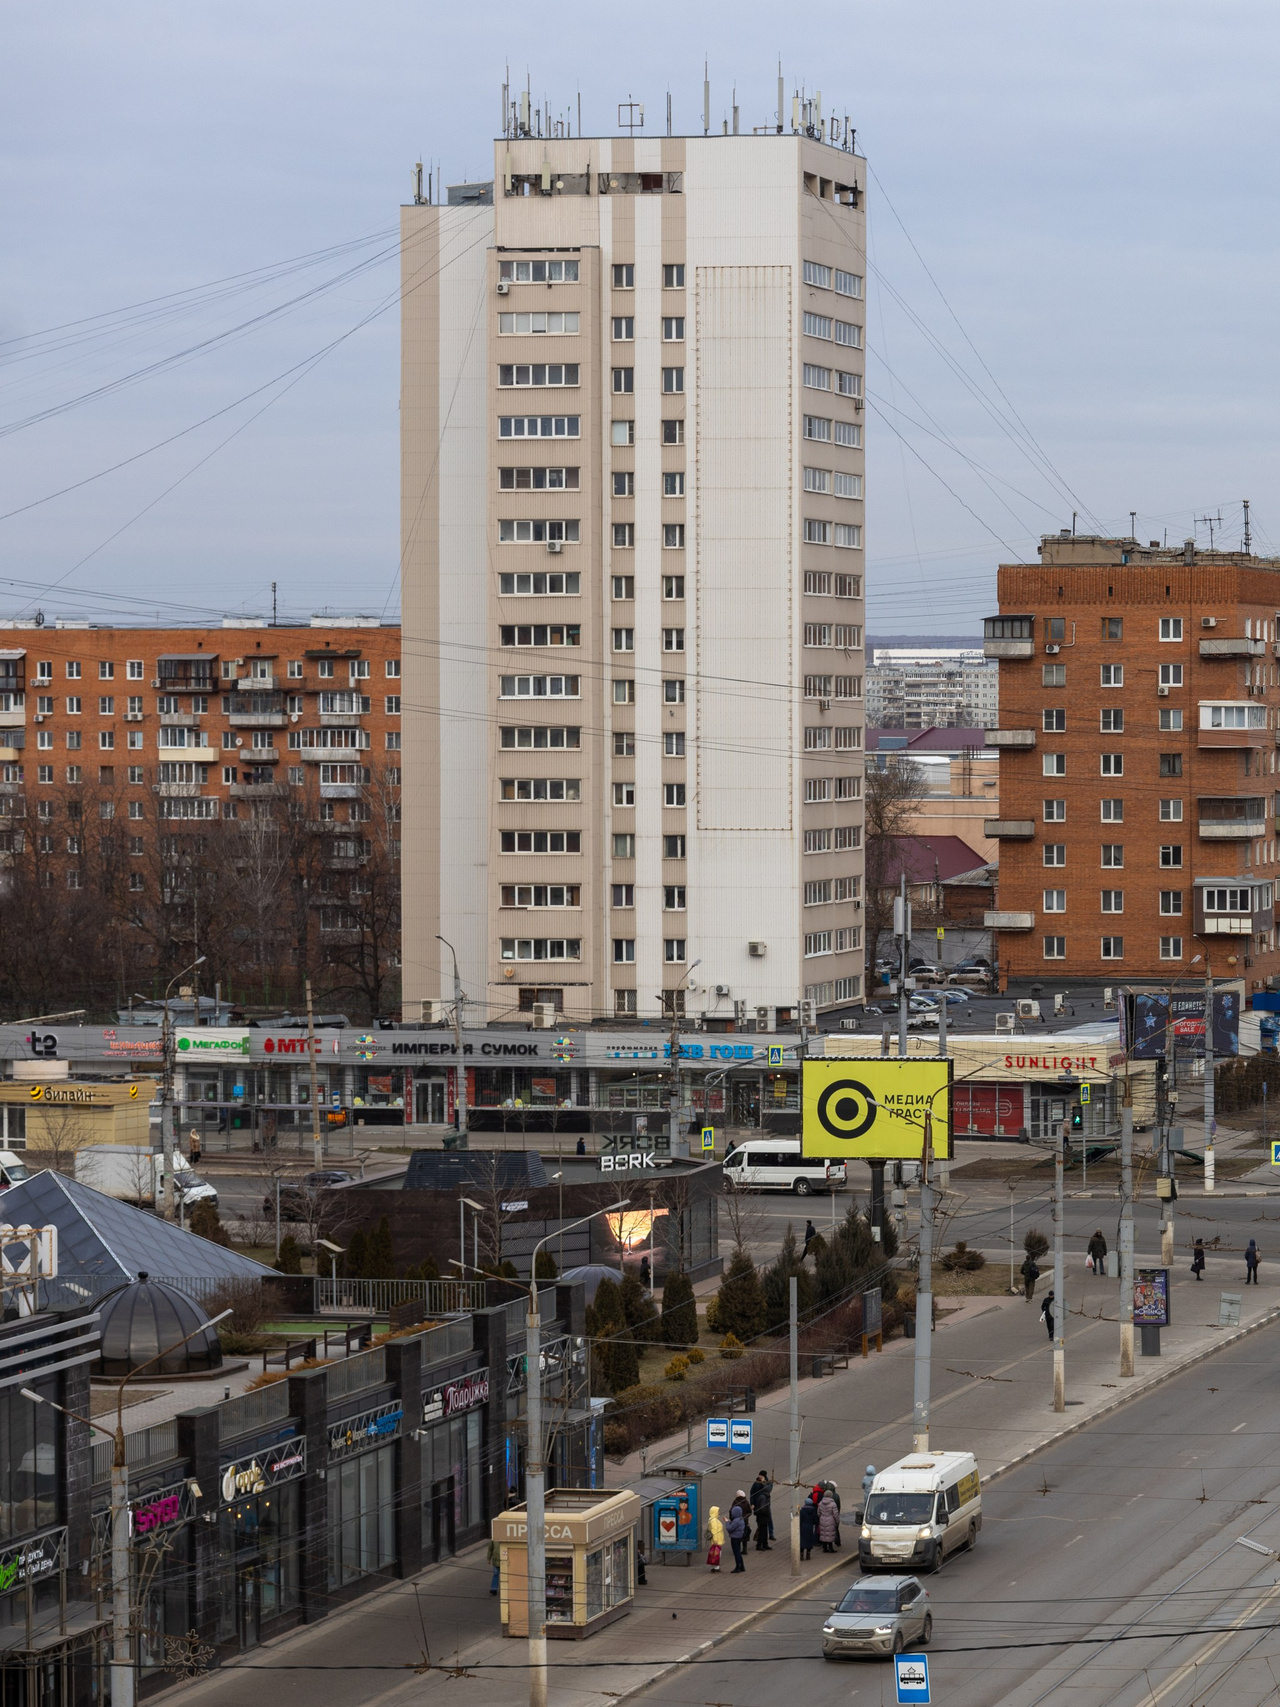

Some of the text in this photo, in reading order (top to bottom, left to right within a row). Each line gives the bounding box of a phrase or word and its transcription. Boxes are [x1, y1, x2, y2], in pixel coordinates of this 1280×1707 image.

[392, 1043, 538, 1056] ИМПЕРИЯ СУМОК
[1005, 1055, 1097, 1070] SUNLIGHT
[44, 1088, 93, 1101] билайн
[884, 1094, 933, 1105] МЕДИА
[601, 1151, 655, 1172] BORK
[446, 1381, 489, 1415] Подружка
[604, 1510, 625, 1531] ПРЕССА
[506, 1523, 573, 1539] ПРССА
